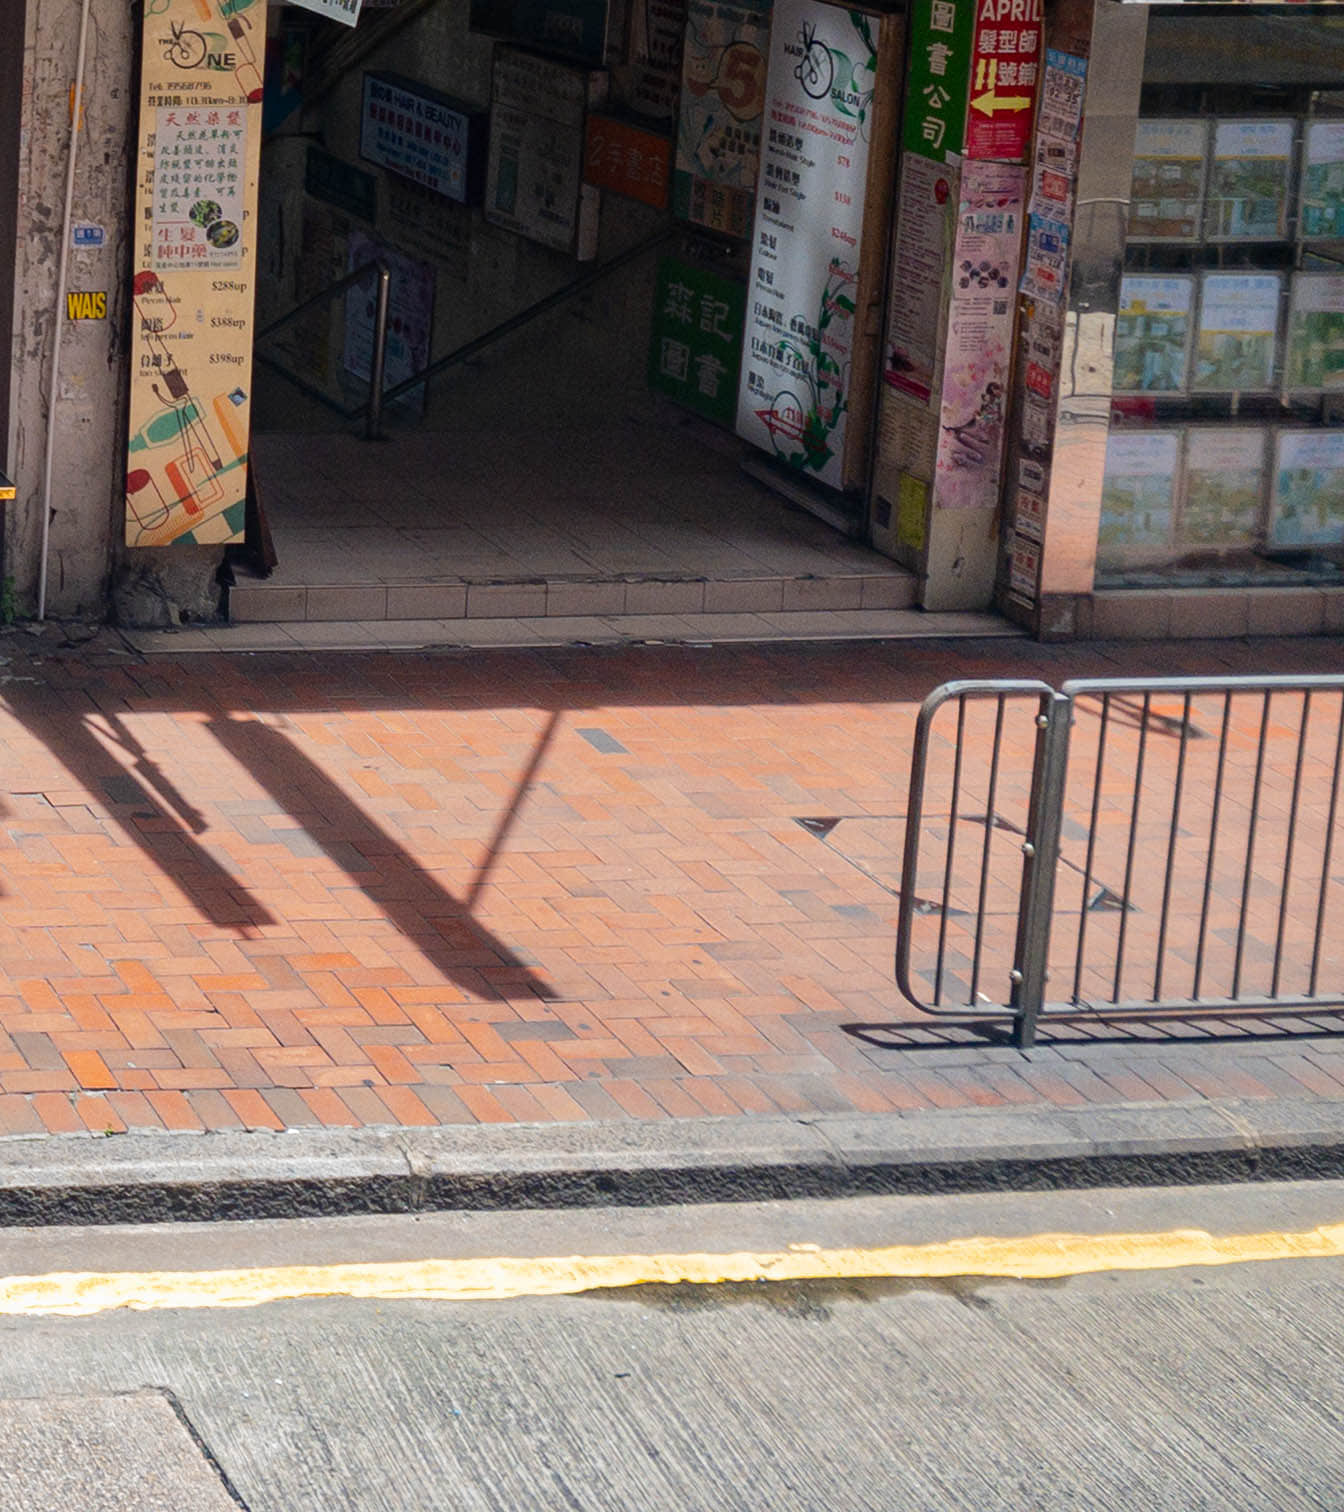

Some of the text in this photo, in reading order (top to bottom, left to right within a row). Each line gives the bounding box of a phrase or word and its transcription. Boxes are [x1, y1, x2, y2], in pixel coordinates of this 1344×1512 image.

[784, 43, 804, 58] HAIR
[978, 29, 1039, 56] 髮型師
[830, 87, 861, 107] SALON
[212, 280, 248, 293] $288up
[67, 292, 107, 320] WAIS
[208, 353, 245, 366] $398up
